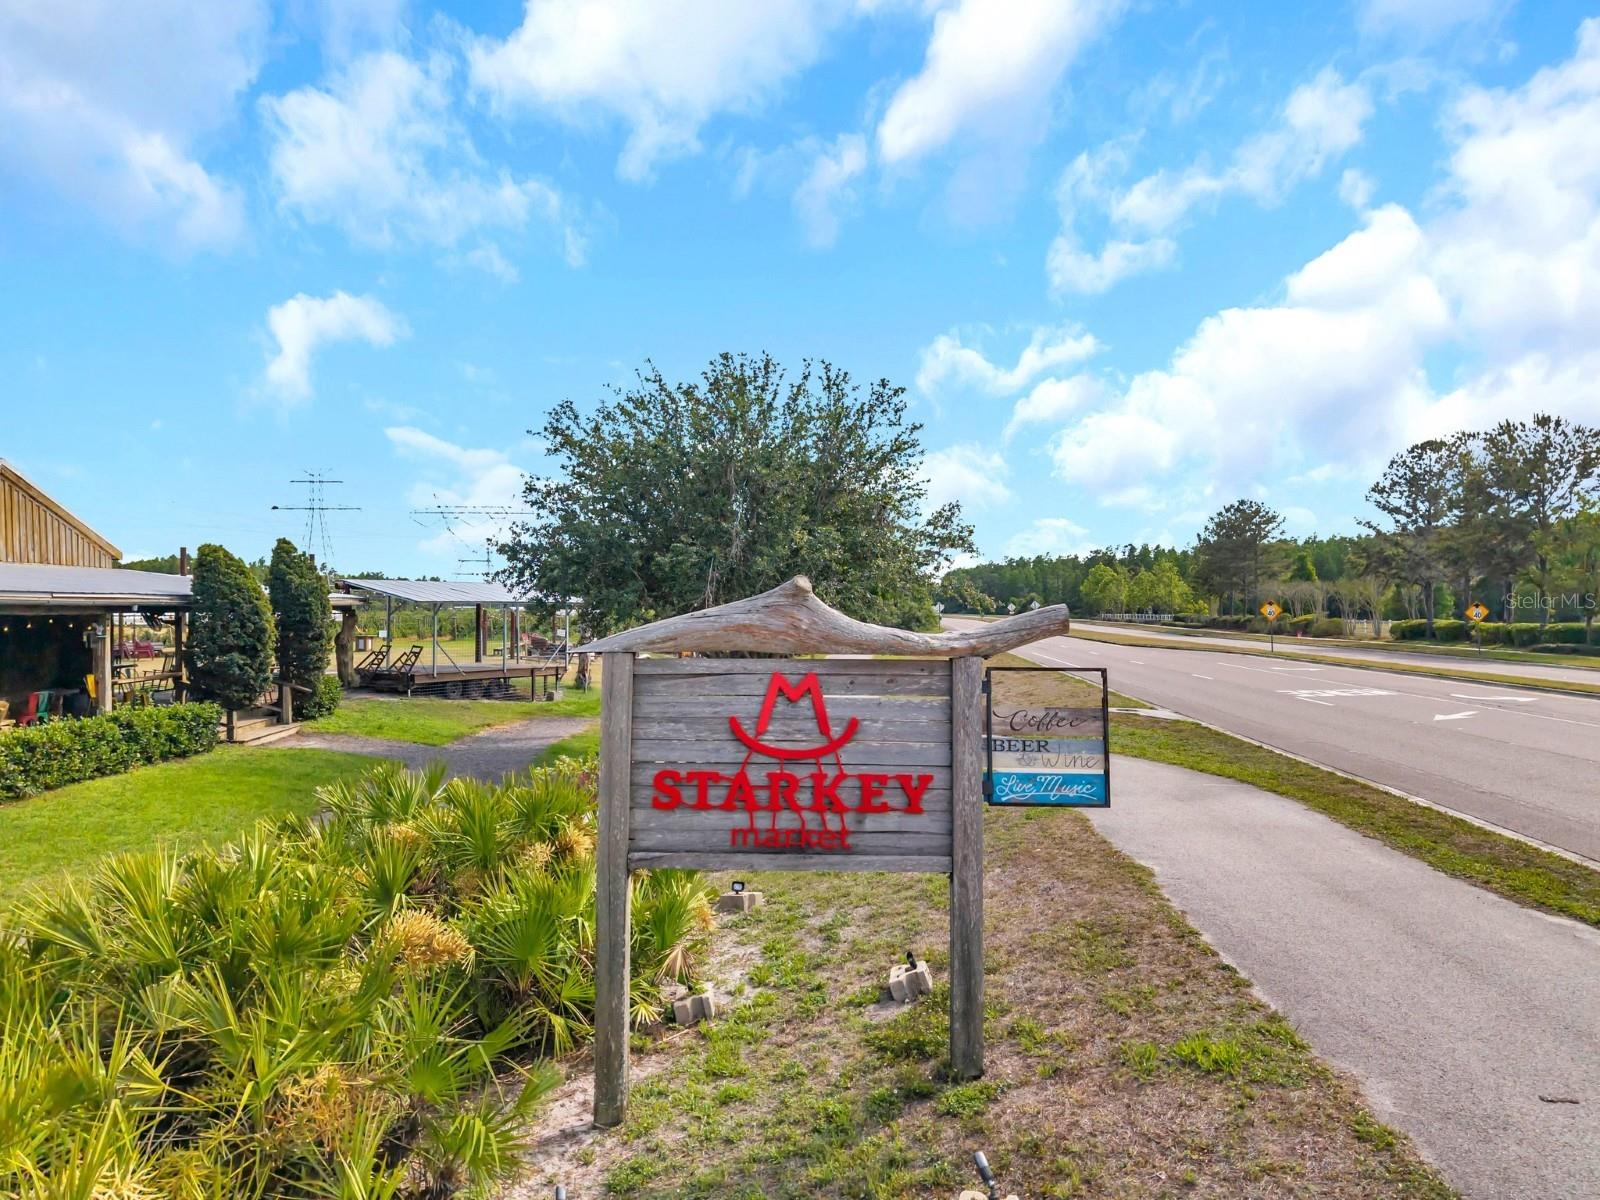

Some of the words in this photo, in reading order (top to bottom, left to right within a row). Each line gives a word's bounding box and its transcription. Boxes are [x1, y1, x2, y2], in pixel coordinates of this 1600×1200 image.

[992, 709, 1090, 732] Coffee
[991, 739, 1050, 753] BEER
[1041, 746, 1100, 768] Wine
[652, 769, 934, 814] STARKEY
[996, 774, 1037, 800] Live
[1036, 775, 1096, 801] Music
[730, 827, 852, 849] market
